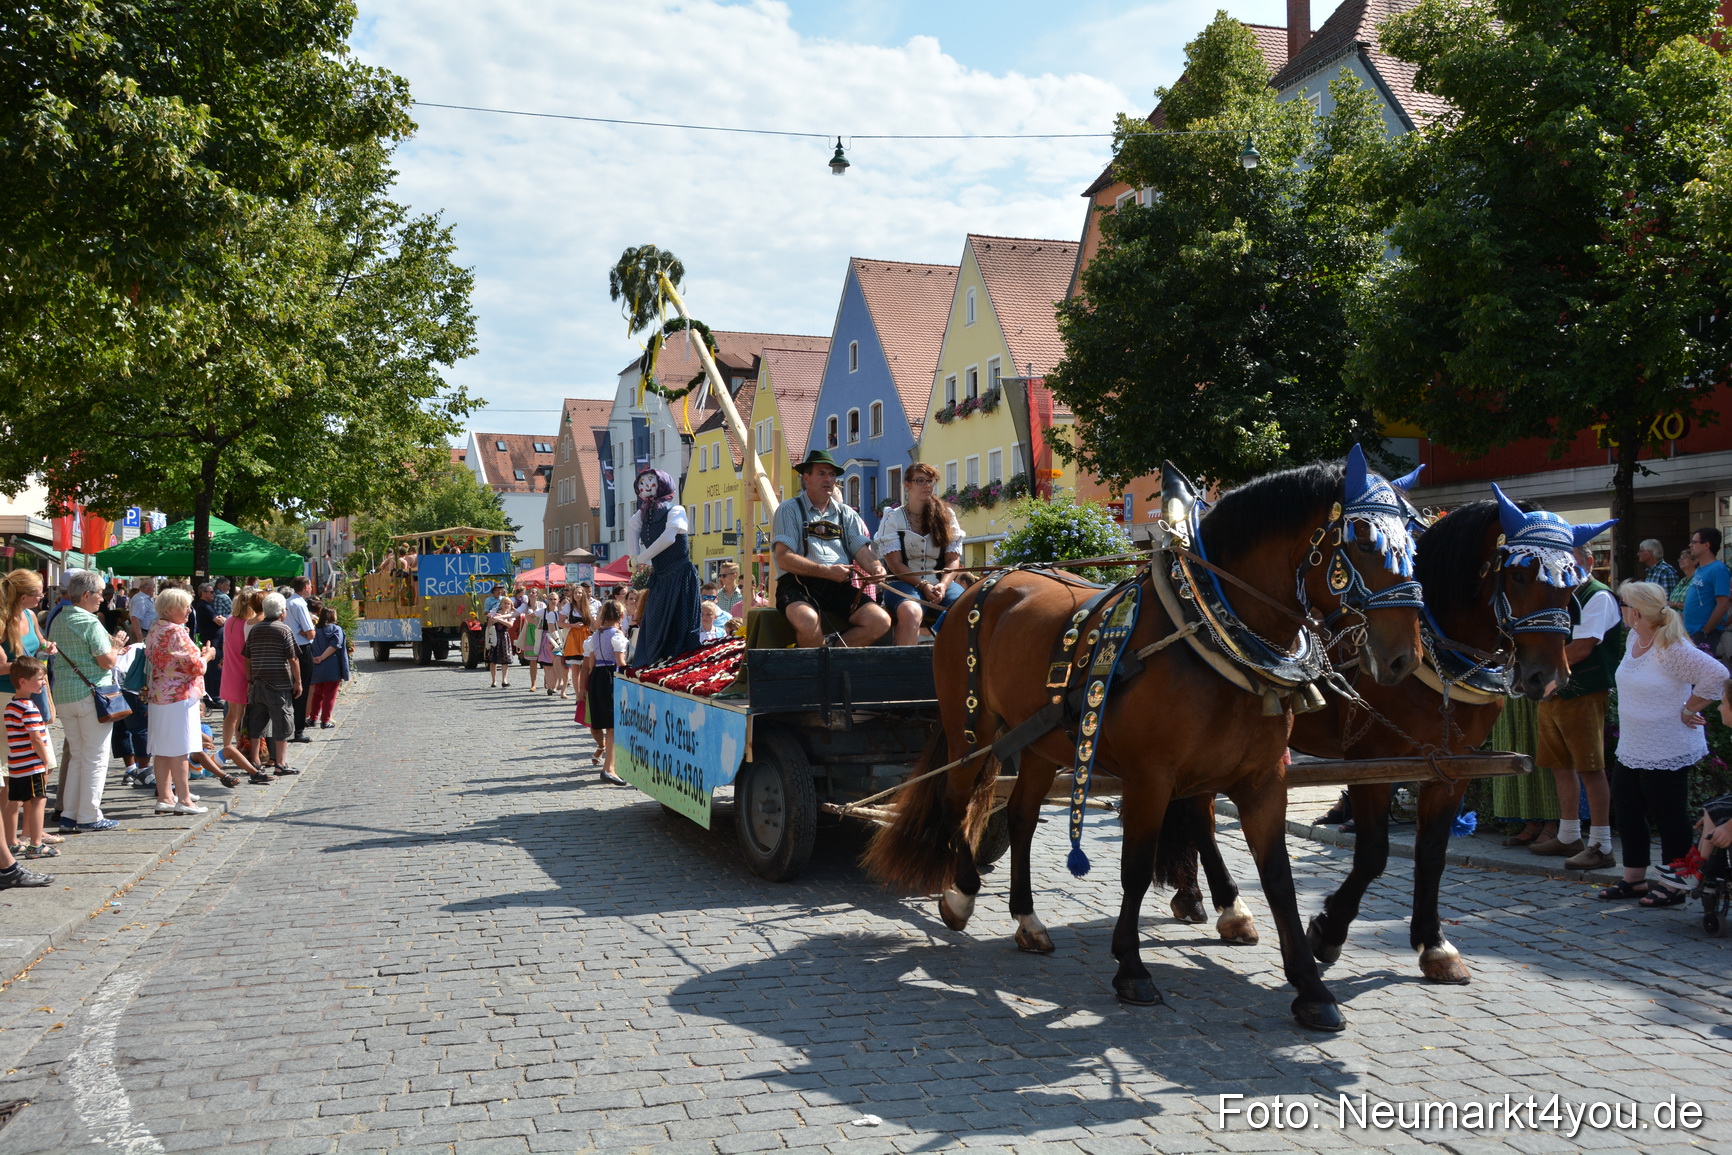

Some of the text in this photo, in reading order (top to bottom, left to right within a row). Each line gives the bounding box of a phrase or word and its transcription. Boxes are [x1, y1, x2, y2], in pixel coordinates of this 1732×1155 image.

[706, 484, 721, 498] HOTEL
[127, 509, 137, 525] P
[705, 546, 725, 556] Restaurant
